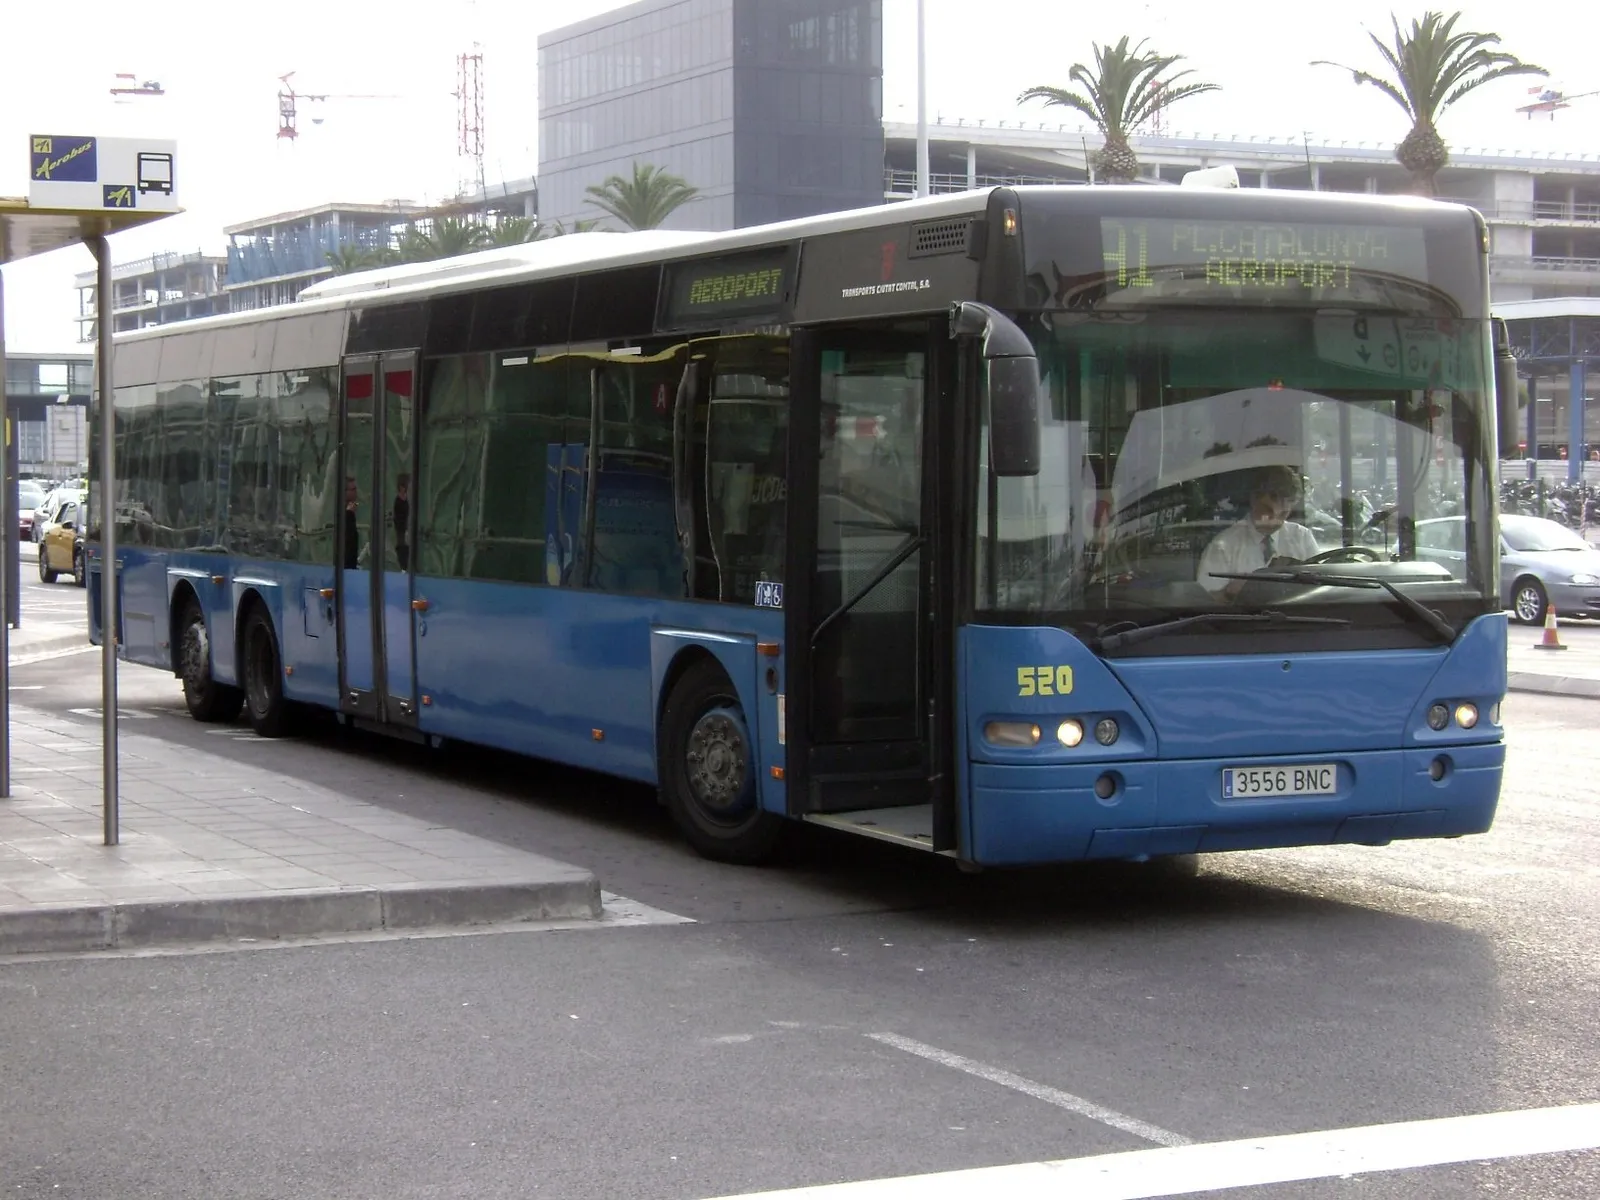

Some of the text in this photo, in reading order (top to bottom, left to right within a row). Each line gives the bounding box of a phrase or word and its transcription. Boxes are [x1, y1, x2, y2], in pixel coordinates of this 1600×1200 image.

[36, 141, 93, 180] Aerobus
[689, 268, 783, 305] AEROPORT
[1205, 256, 1356, 289] AEROPORT
[842, 285, 876, 298] TRANSPORTS
[1017, 665, 1073, 697] 520
[1237, 771, 1287, 793] 3556
[1294, 769, 1331, 791] BNC
